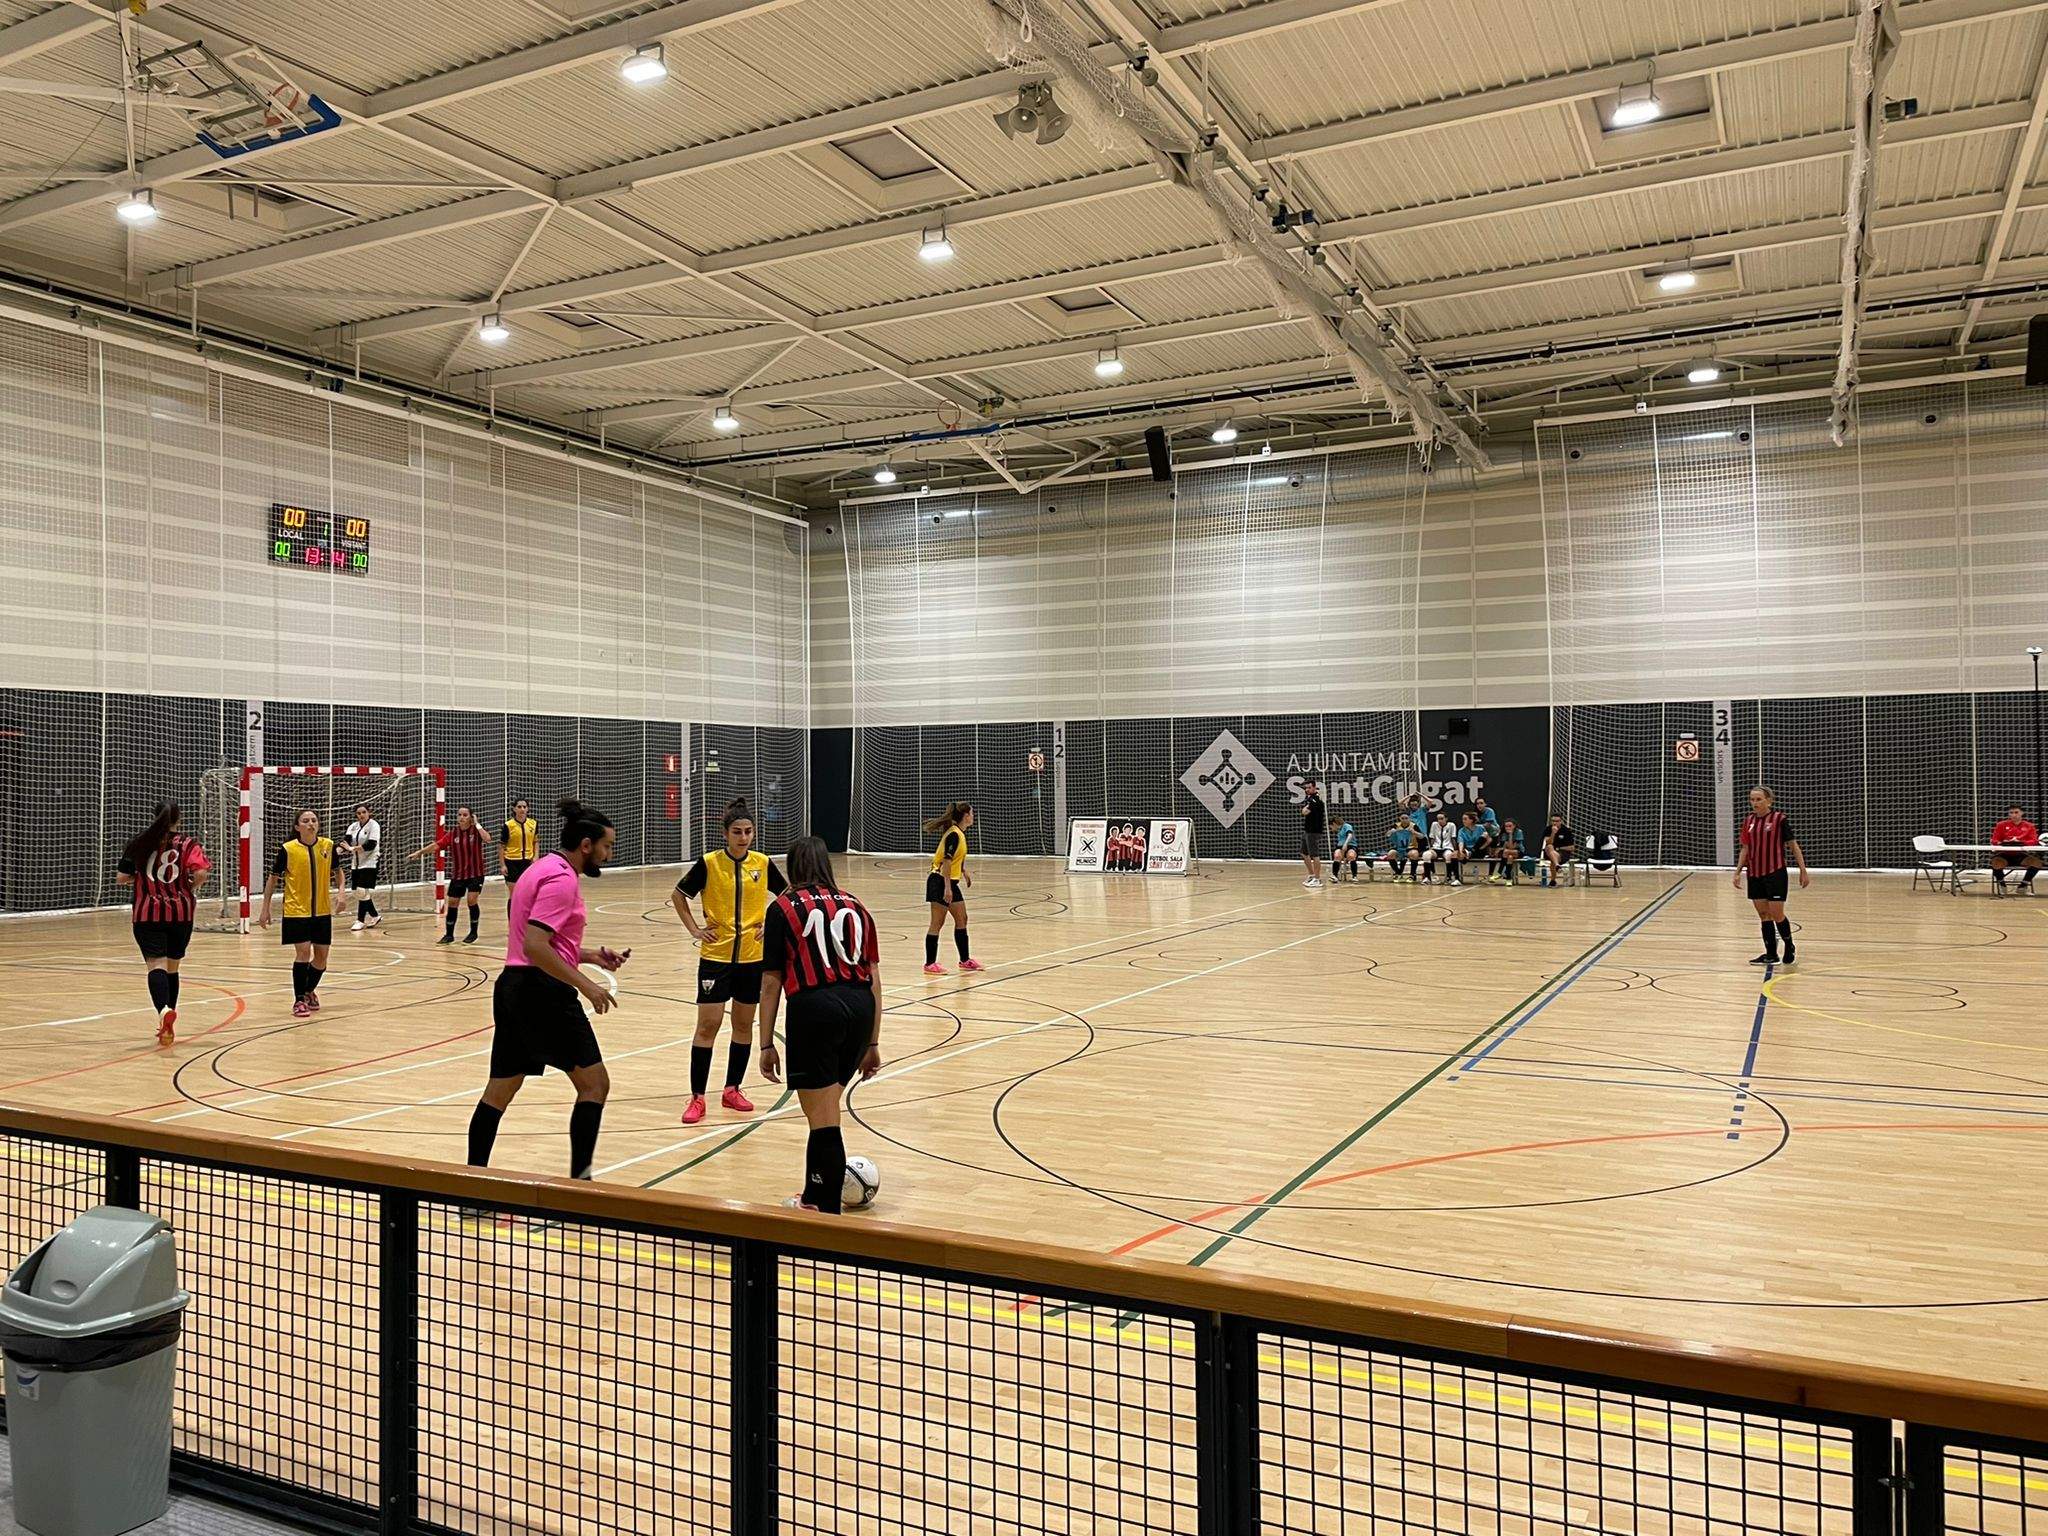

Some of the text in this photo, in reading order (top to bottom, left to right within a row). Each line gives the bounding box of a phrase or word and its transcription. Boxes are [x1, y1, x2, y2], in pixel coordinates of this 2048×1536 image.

[283, 508, 305, 528] 00
[278, 529, 304, 540] LOCAL
[346, 519, 367, 538] 00
[274, 541, 291, 557] 00
[353, 553, 367, 568] 00
[249, 710, 262, 731] 2
[1715, 709, 1729, 726] 3
[1055, 728, 1062, 742] 1
[1715, 728, 1731, 746] 4
[1055, 745, 1064, 758] 2
[1287, 751, 1484, 773] AJUNTAMENT DE
[801, 907, 863, 969] 10
